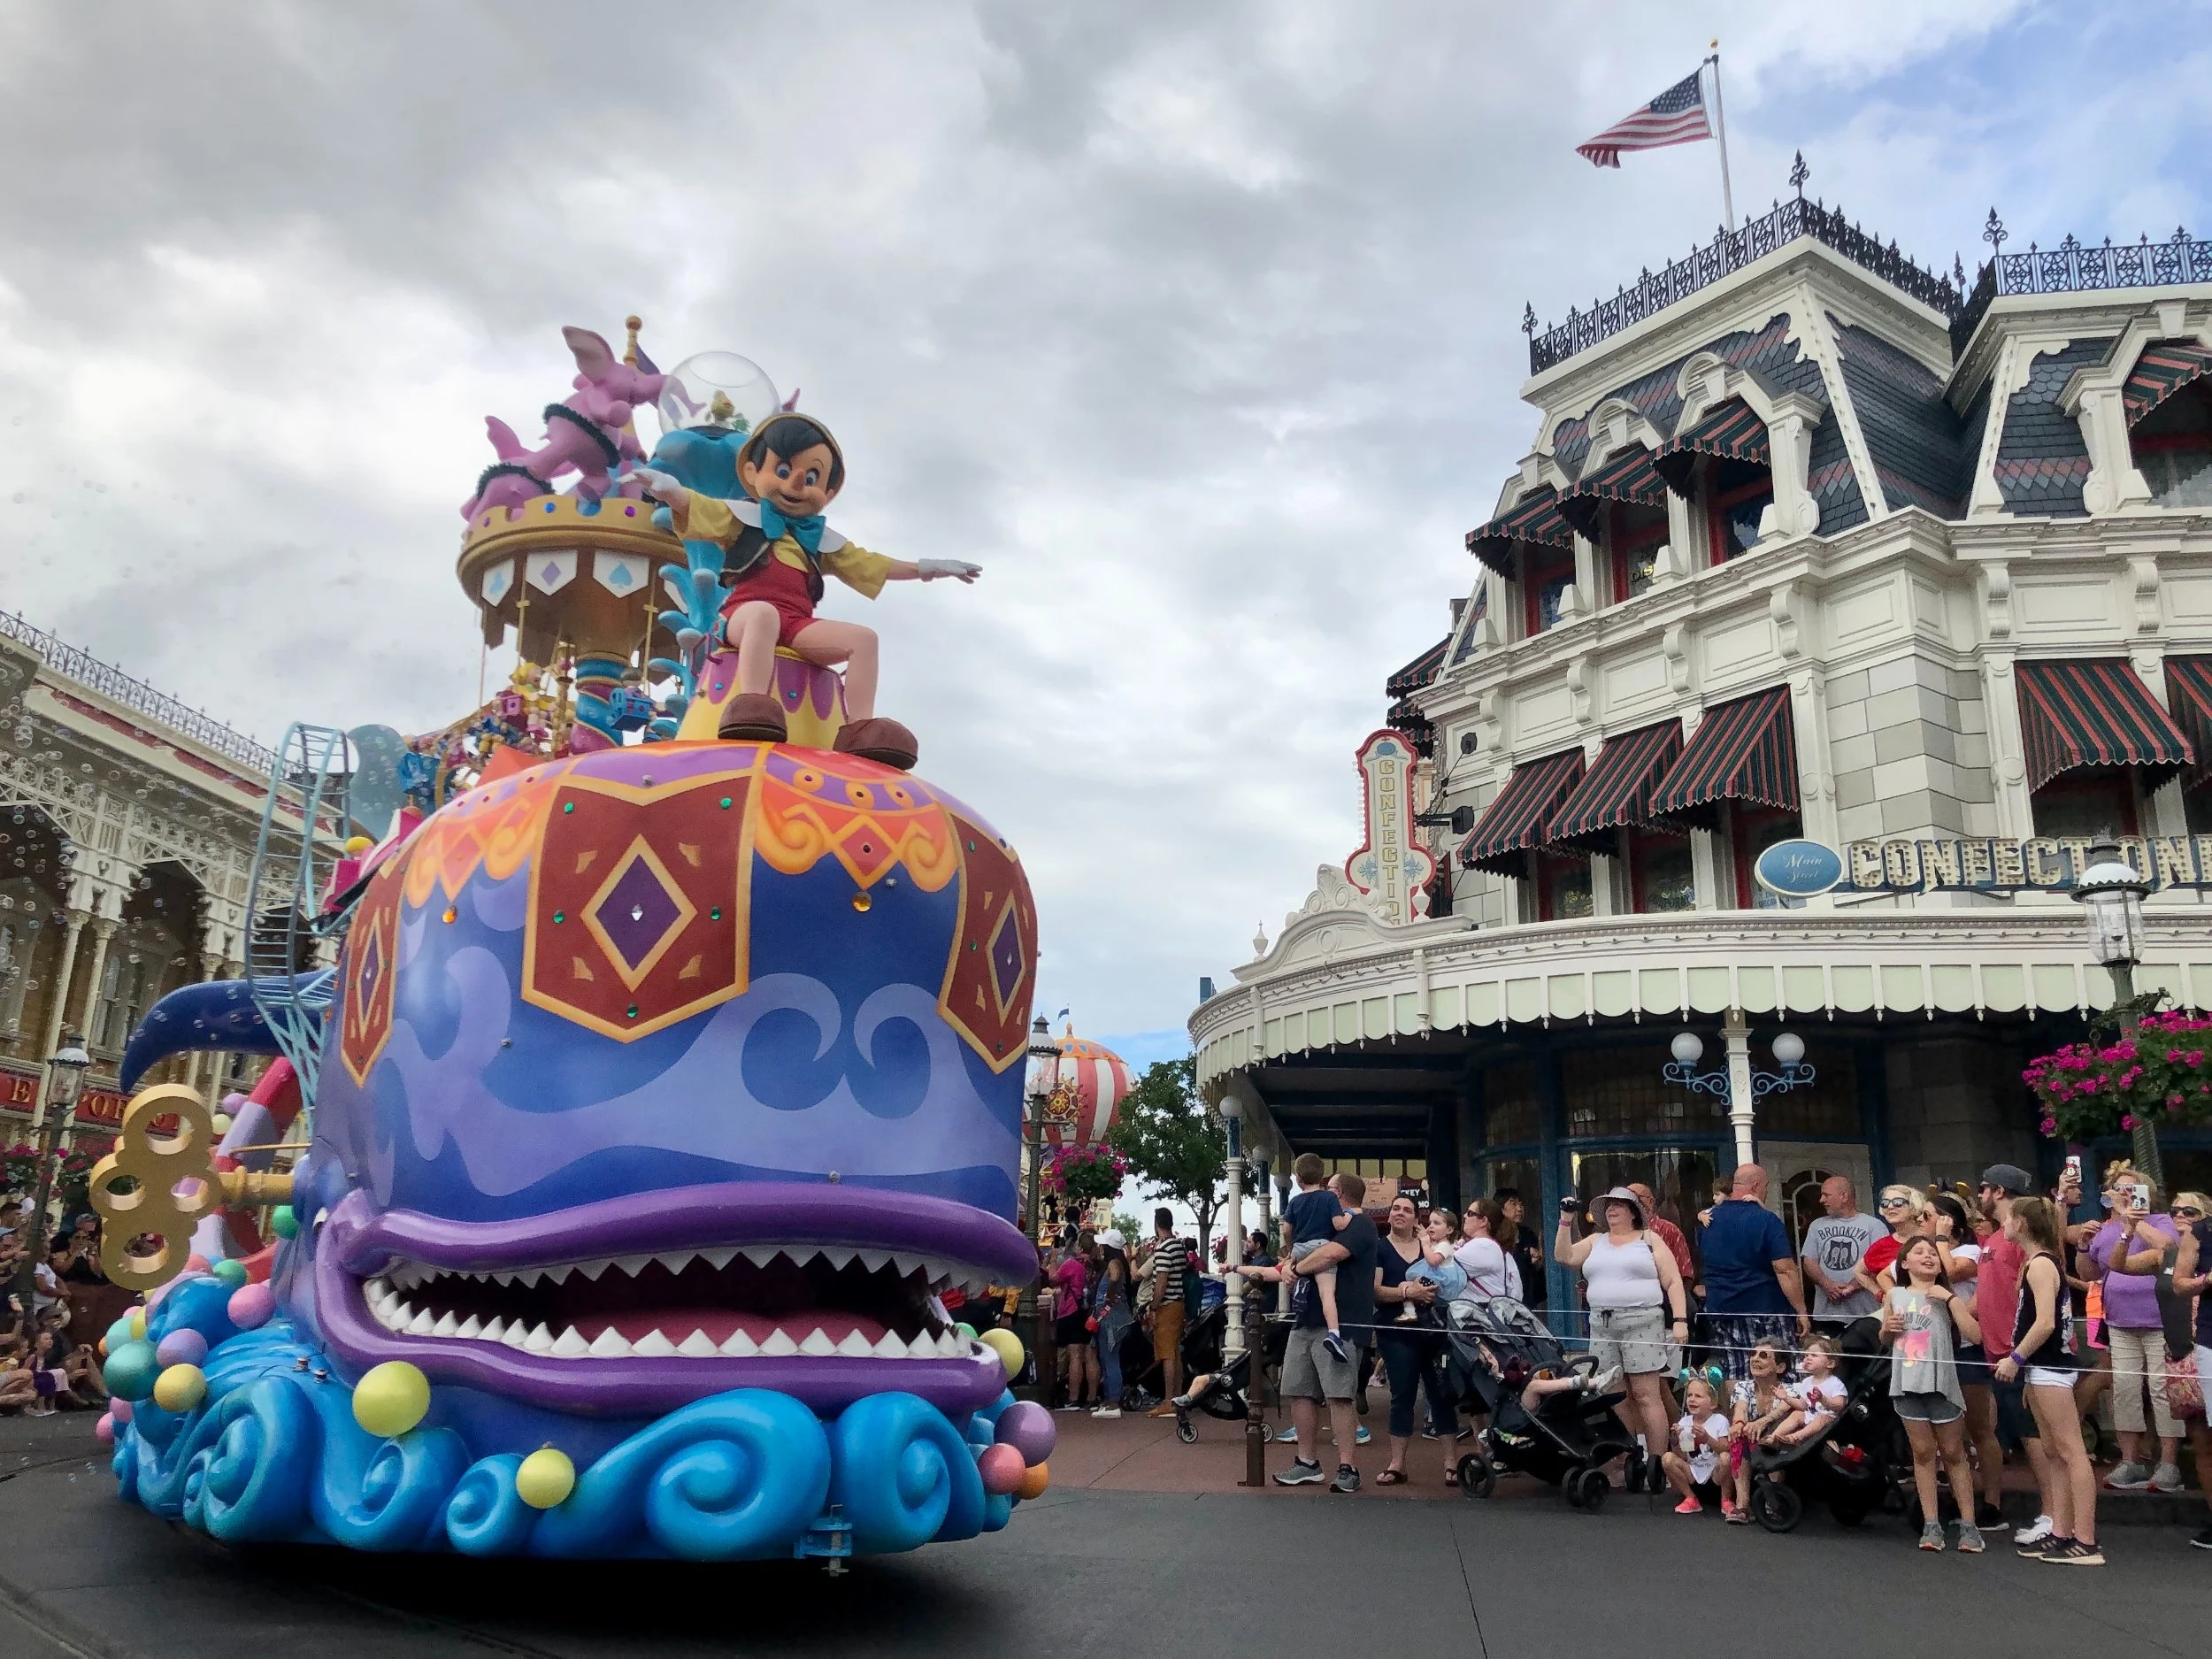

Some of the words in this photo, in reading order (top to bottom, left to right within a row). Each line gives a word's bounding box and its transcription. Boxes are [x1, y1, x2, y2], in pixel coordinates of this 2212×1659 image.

[1379, 759, 1402, 925] CONFECTI
[1786, 853, 1824, 868] Main
[1849, 833, 2212, 895] CONFECTON
[1817, 1225, 1870, 1242] BROOKLYN
